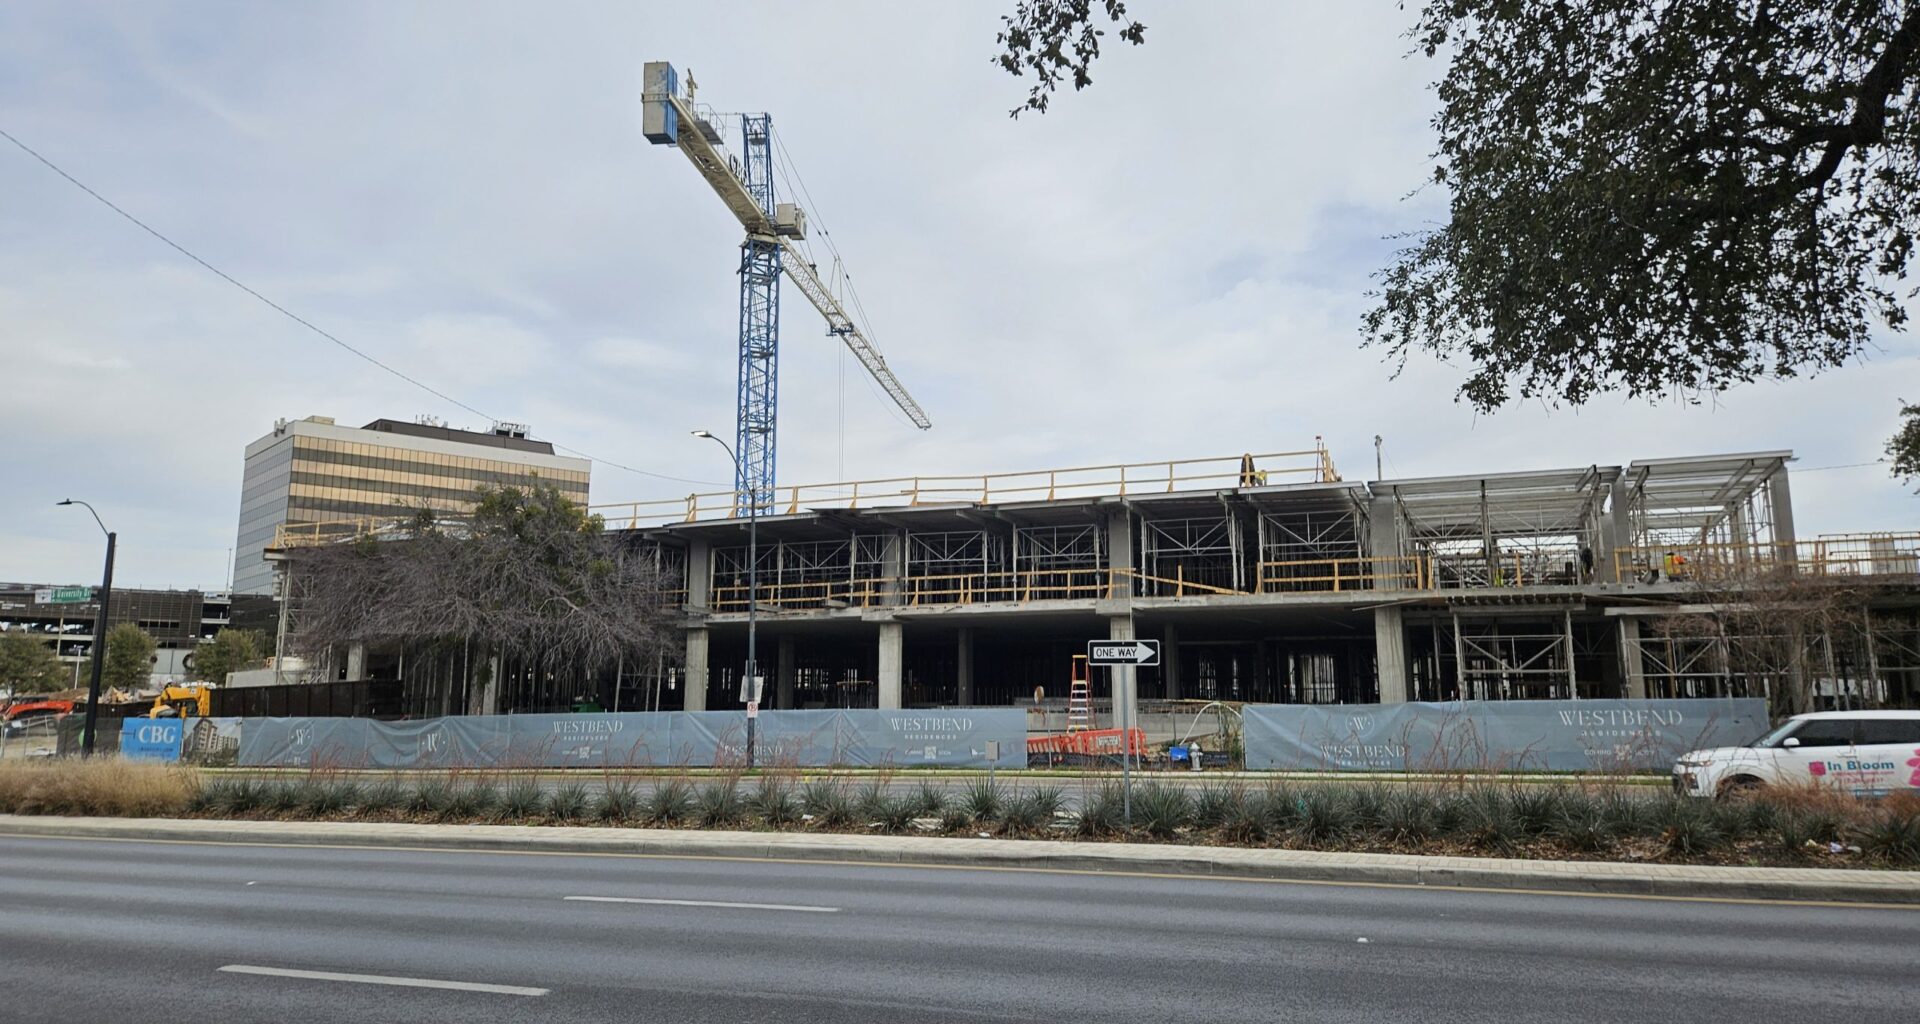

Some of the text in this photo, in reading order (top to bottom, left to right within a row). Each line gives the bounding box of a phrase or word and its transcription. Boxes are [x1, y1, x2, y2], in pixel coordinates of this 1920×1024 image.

[57, 589, 82, 598] University
[1096, 648, 1138, 657] ONE WAY
[891, 717, 972, 731] WESTBEND
[1558, 709, 1683, 726] WESTBEND
[553, 720, 623, 733] WESTBEND
[138, 725, 176, 744] CBG
[1827, 760, 1895, 771] In Bloom
